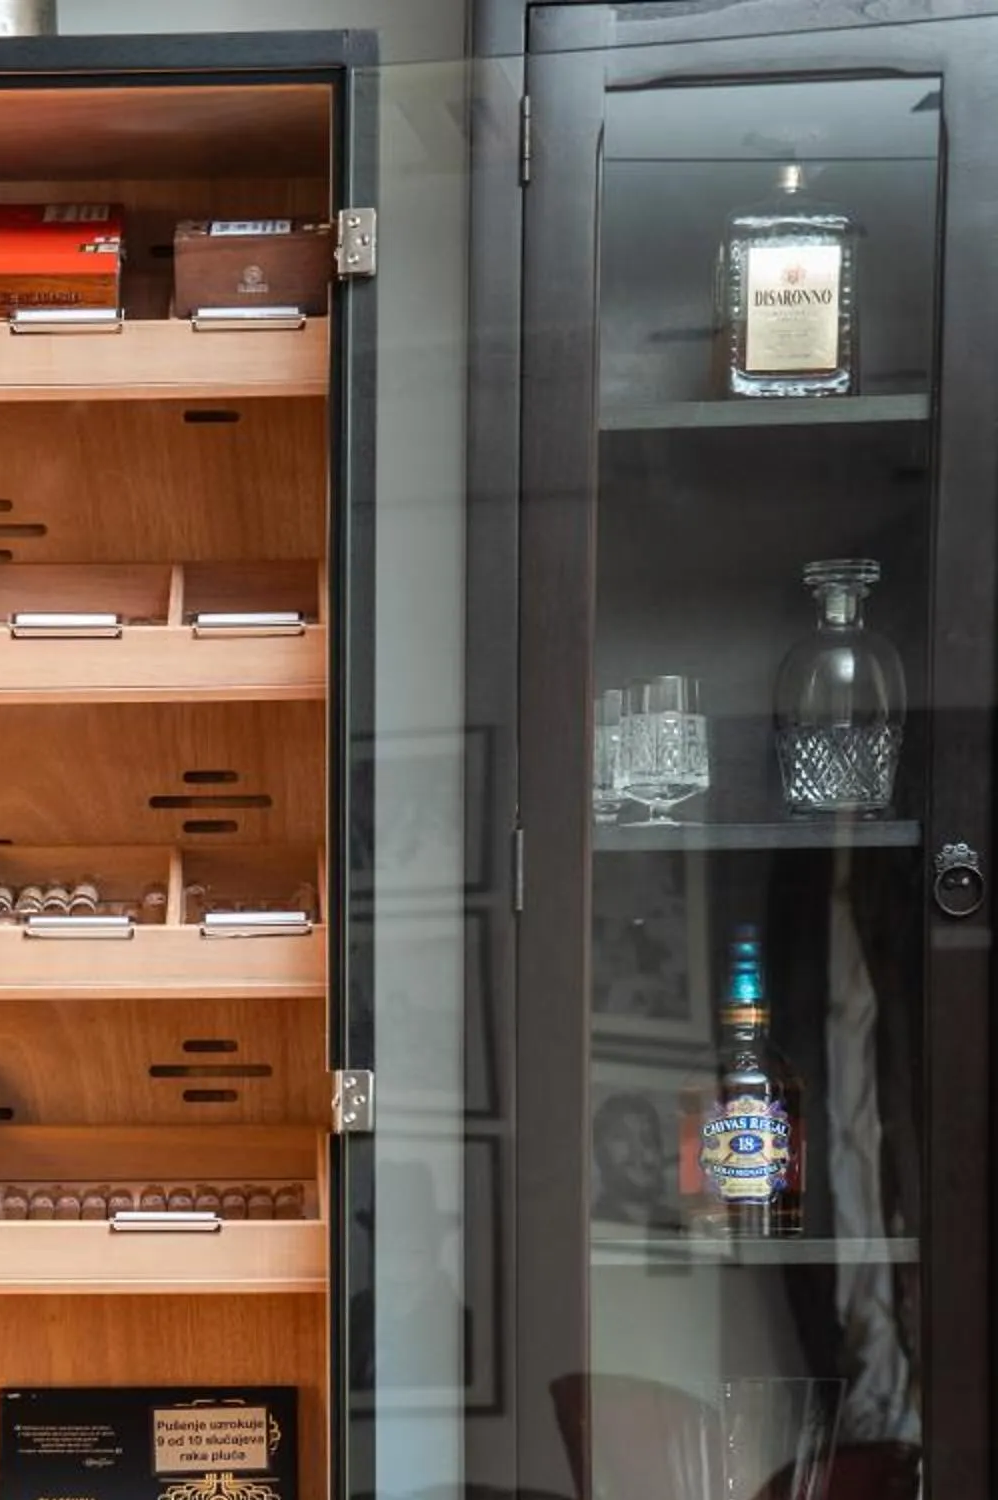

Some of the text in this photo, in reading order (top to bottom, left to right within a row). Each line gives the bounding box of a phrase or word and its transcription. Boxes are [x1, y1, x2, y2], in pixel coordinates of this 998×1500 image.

[754, 287, 832, 308] DISARONNO
[703, 1116, 787, 1137] CHIVAS REGAL
[738, 1137, 755, 1152] 18
[157, 1418, 264, 1432] Pušenje uzrokuje
[157, 1436, 165, 1446] 9
[168, 1435, 185, 1446] od
[188, 1435, 203, 1445] 10
